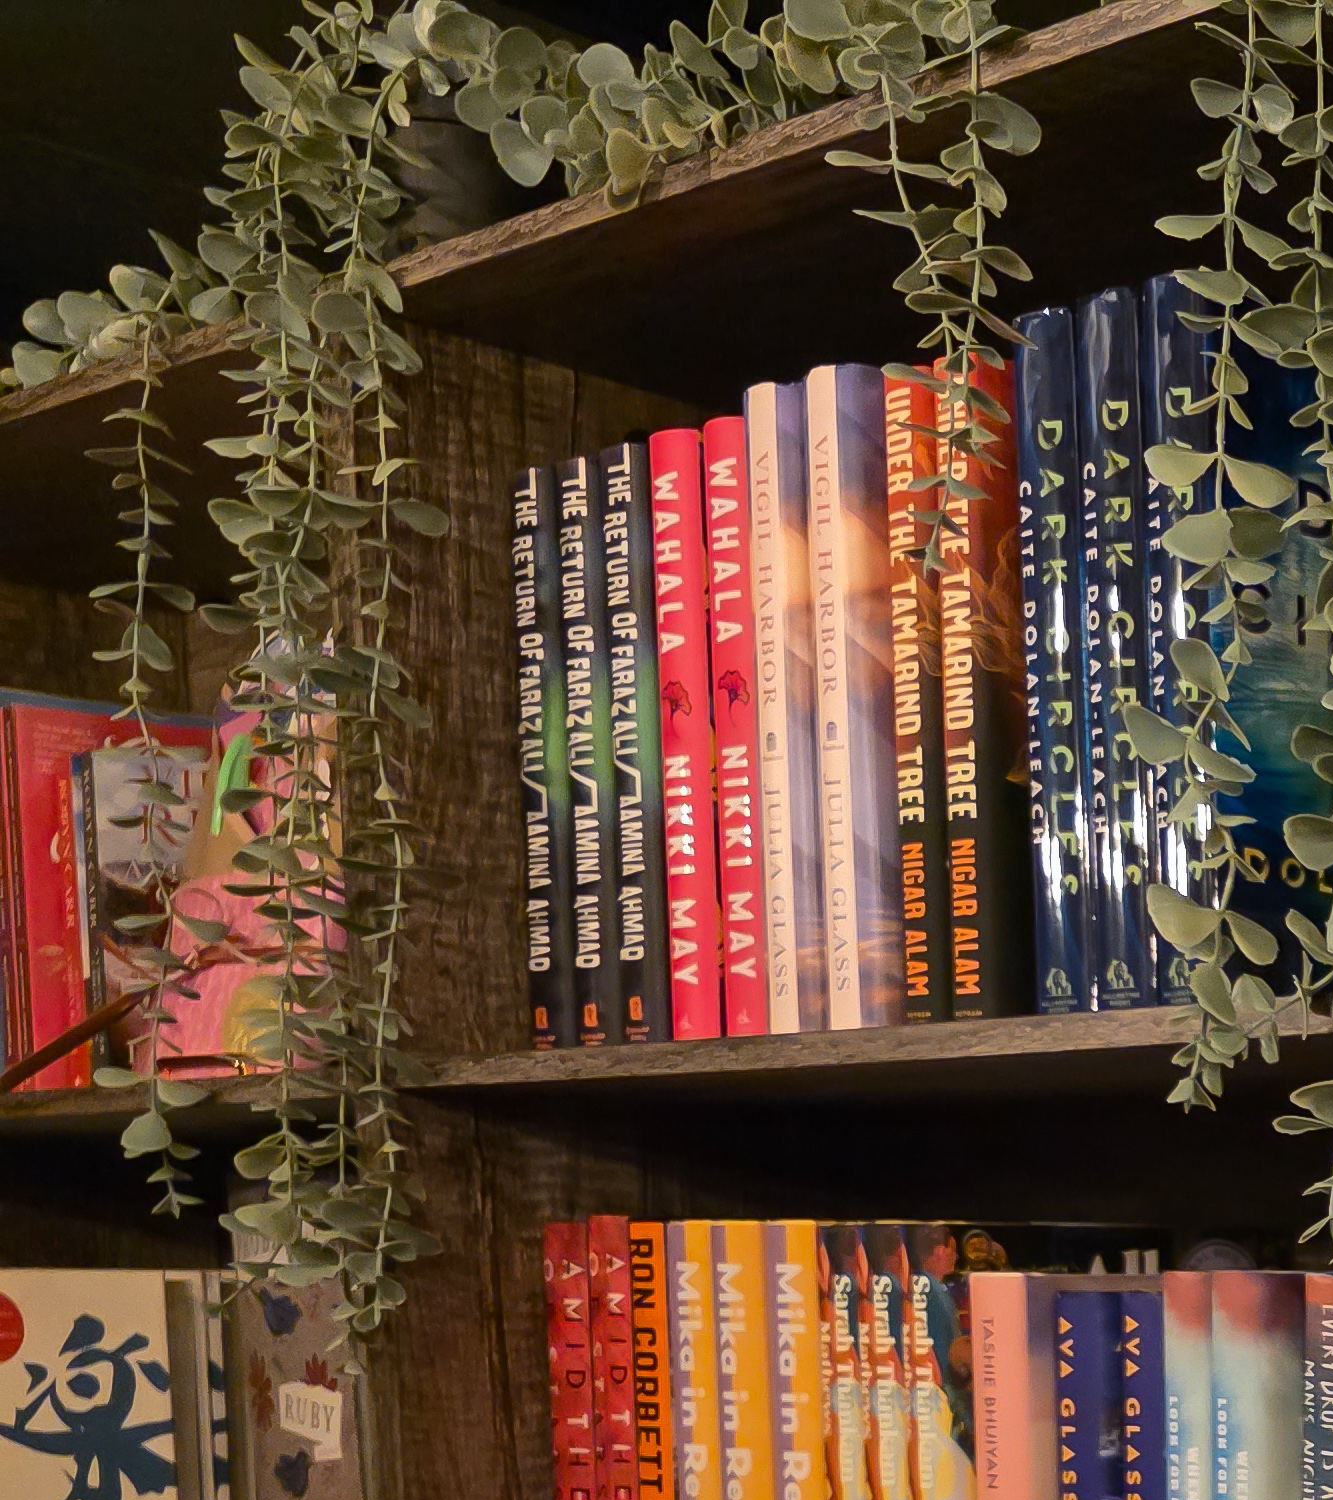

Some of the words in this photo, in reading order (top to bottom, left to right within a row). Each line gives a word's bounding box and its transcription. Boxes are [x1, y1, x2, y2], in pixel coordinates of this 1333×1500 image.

[607, 442, 632, 506] THE
[604, 512, 631, 606] RETURN
[654, 471, 686, 656] WAHALA
[612, 612, 638, 640] OF
[891, 577, 924, 739] TAMARIND
[611, 647, 636, 717] FARAZ
[664, 755, 696, 876] NIKKI
[895, 741, 925, 826] TREE
[901, 841, 928, 919] NIGAR
[671, 898, 699, 986] MAY
[902, 929, 929, 997] ALAM
[629, 1238, 657, 1310] RON
[775, 1262, 806, 1377] Mika
[1123, 1315, 1141, 1378] AVA
[283, 1392, 336, 1434] RUBY
[633, 1327, 663, 1494] CORBETT
[780, 1392, 809, 1434] in
